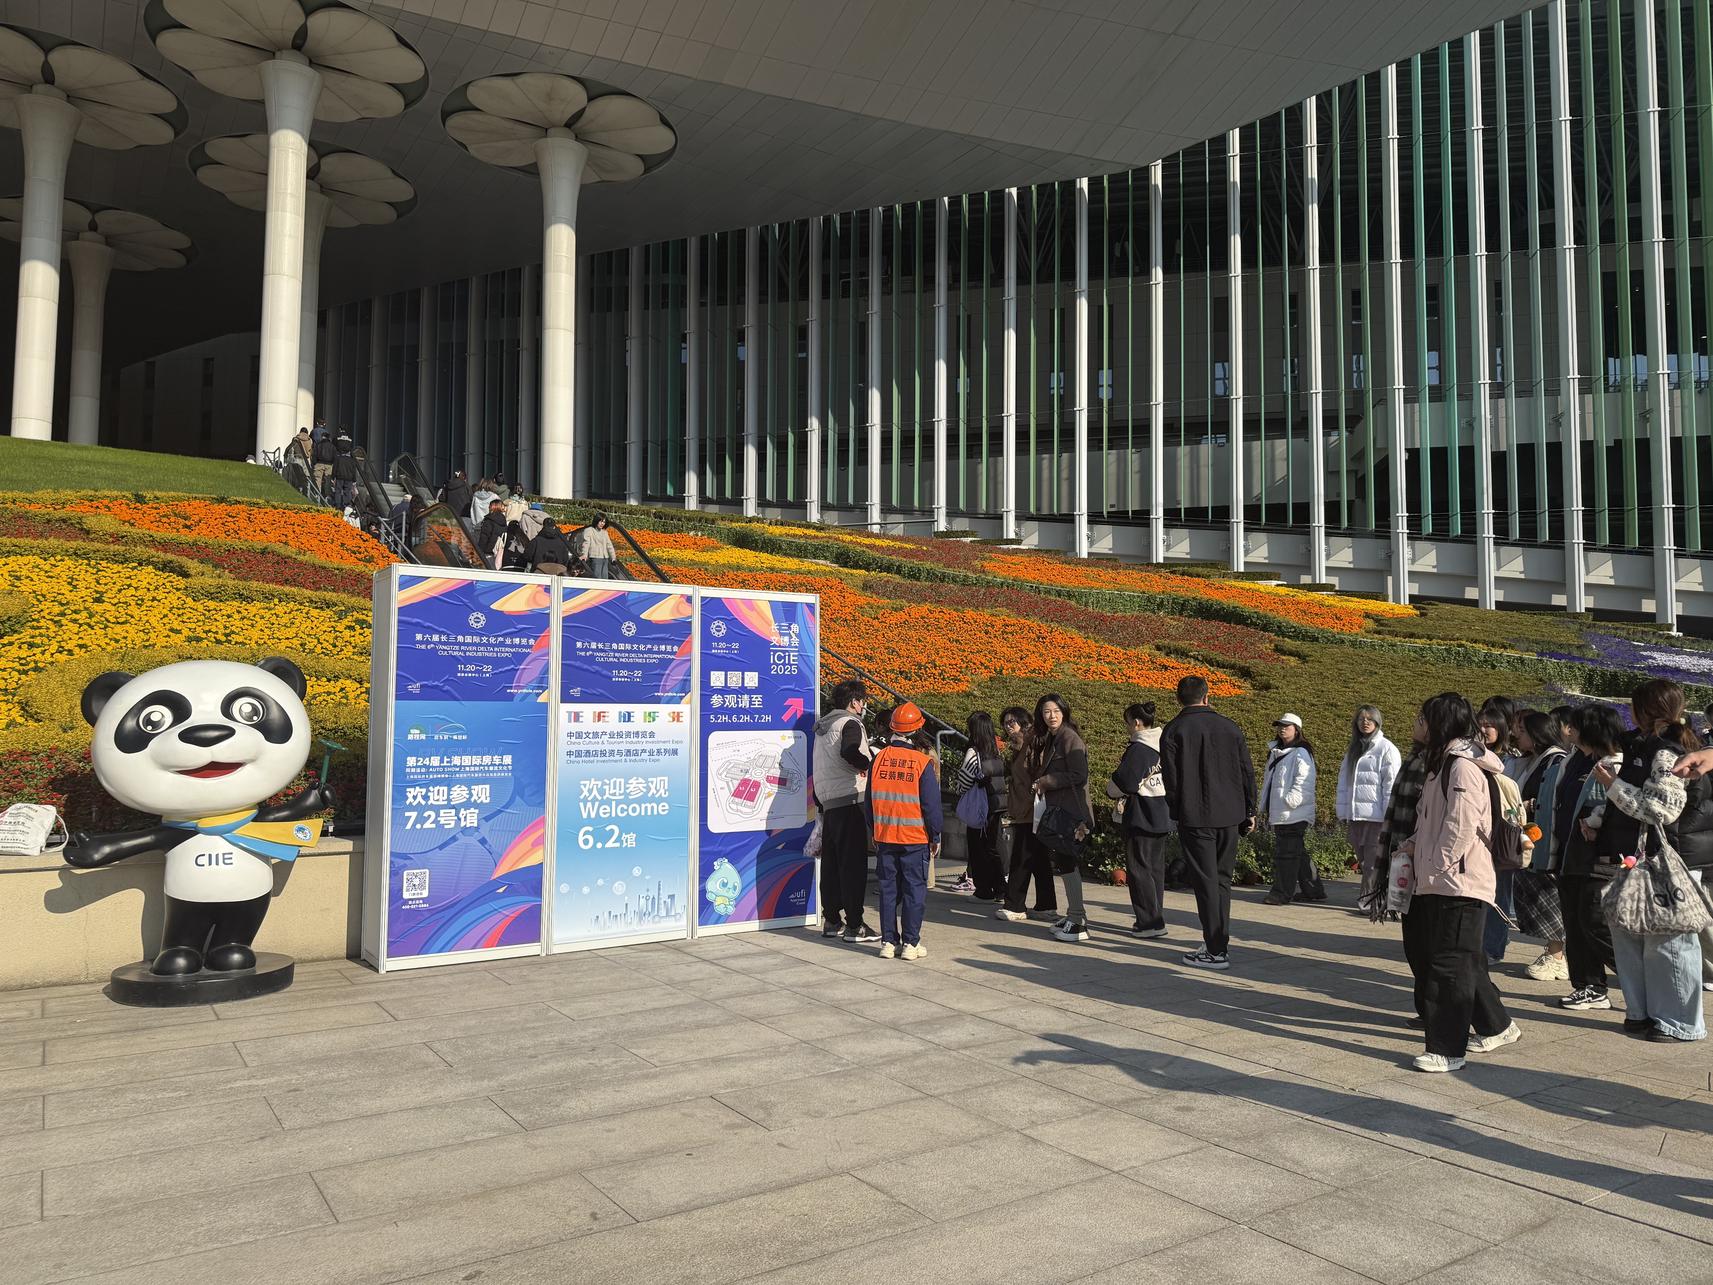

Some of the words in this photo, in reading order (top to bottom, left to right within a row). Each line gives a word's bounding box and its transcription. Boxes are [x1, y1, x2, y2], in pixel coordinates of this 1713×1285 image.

[415, 633, 536, 646] 第六届长三角国际文化产业博览会
[576, 641, 679, 652] 第六届长三角国际文化产业博览会
[770, 665, 798, 674] 2025
[710, 694, 763, 708] 参观请至
[566, 730, 656, 740] 中国文旅产业投资博览会
[566, 748, 679, 758] 中国酒店投资与酒店产业系列展
[406, 754, 512, 767] 第24届上海国际房车展
[880, 758, 917, 770] 上海建工
[879, 770, 915, 783] 安装集团
[406, 784, 491, 806] 欢迎参观
[579, 776, 669, 801] 欢迎参观
[579, 800, 670, 819] Welcome
[405, 808, 479, 830] 7.2号馆
[577, 824, 637, 850] 6.2馆
[194, 852, 234, 867] CIIE
